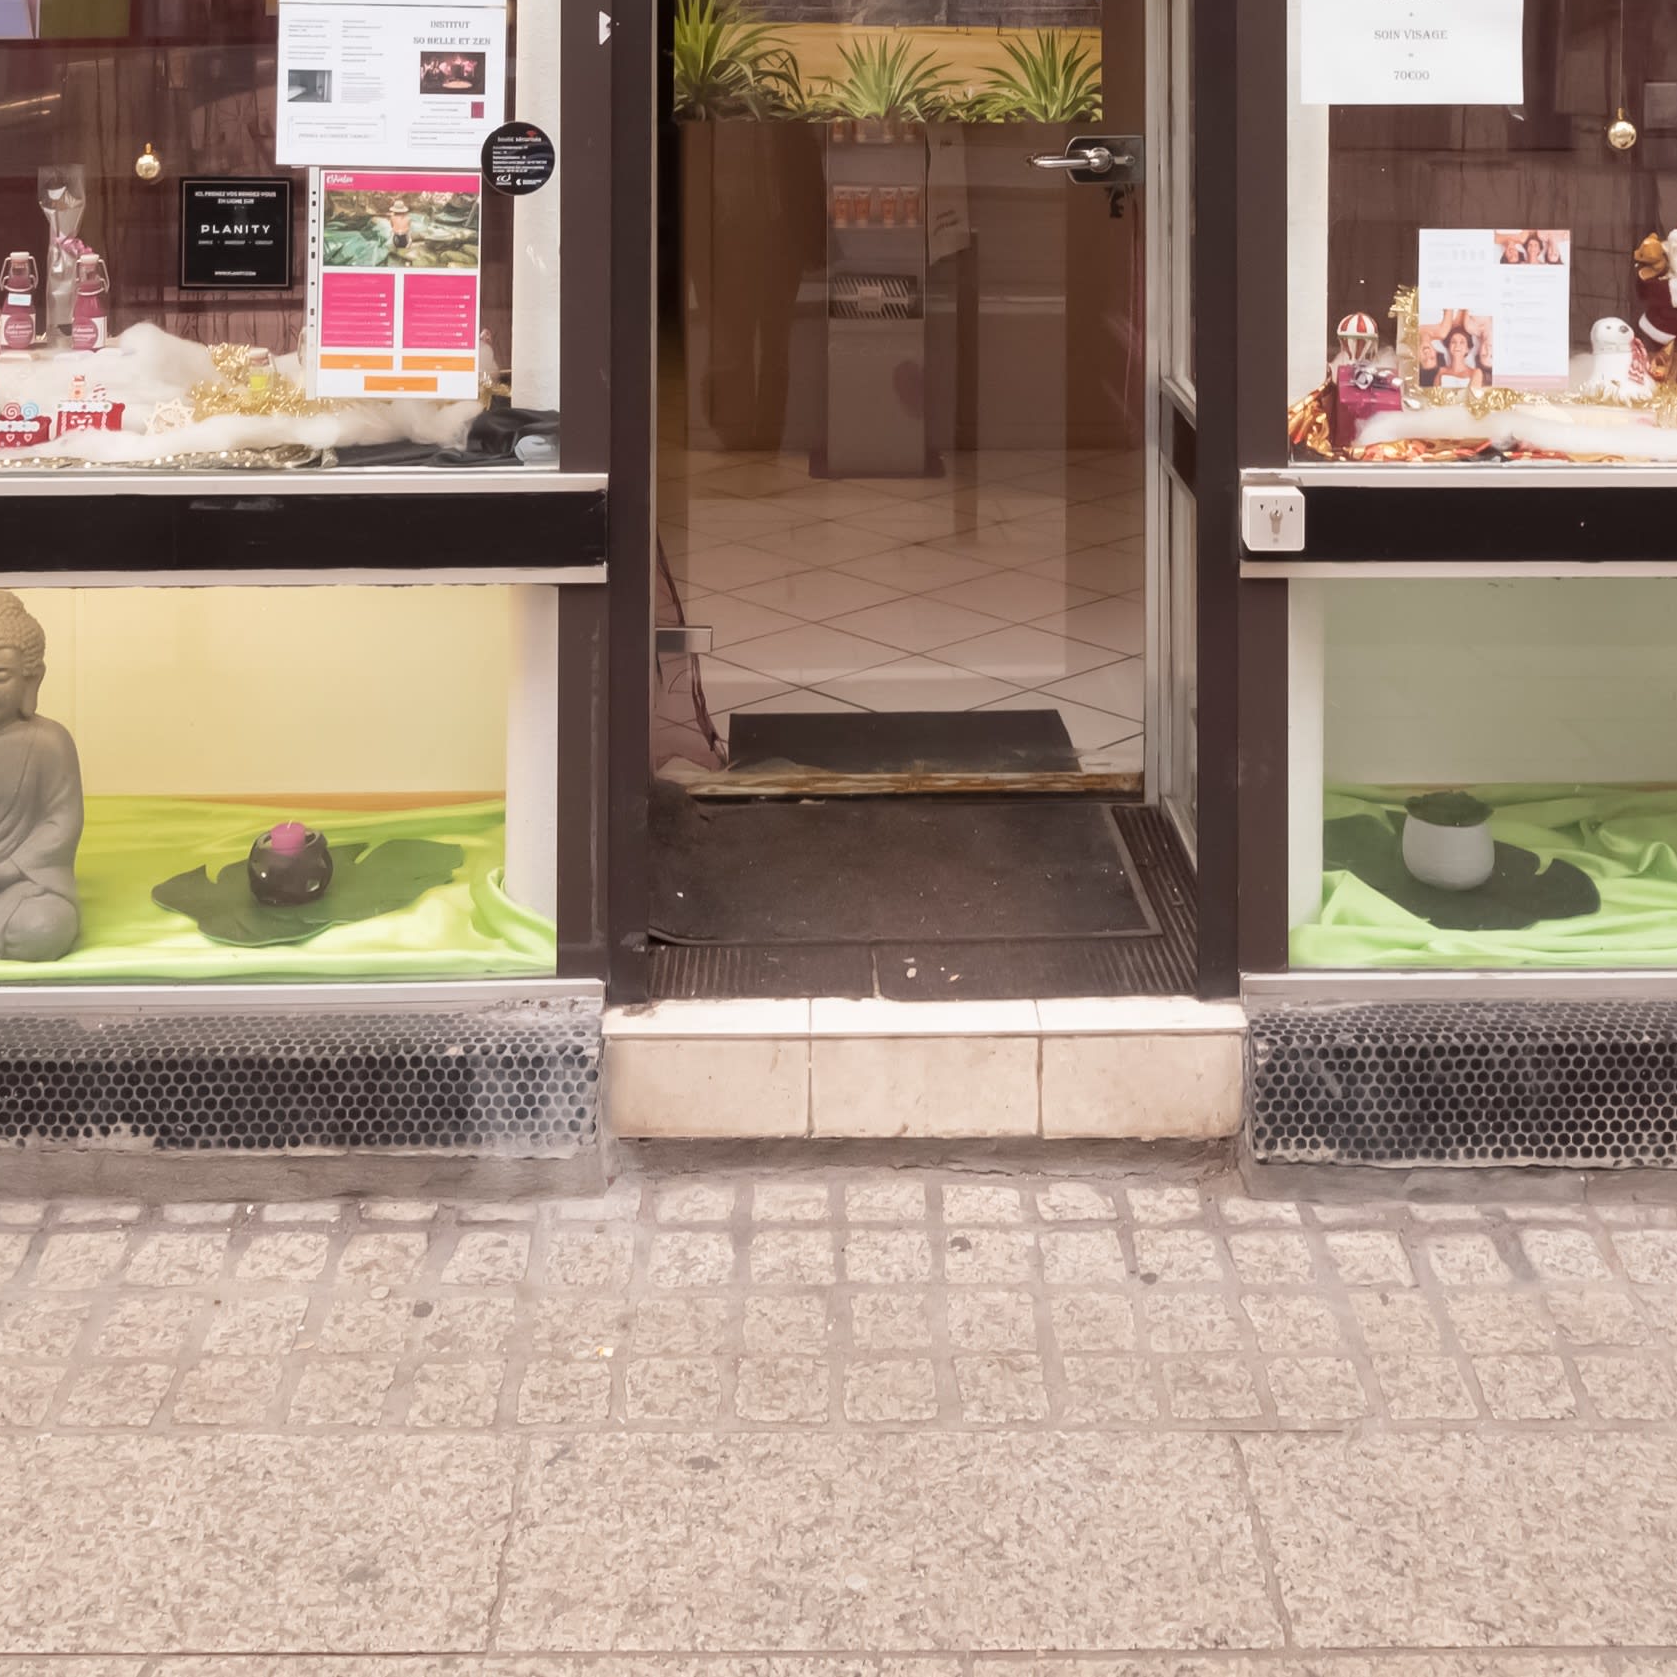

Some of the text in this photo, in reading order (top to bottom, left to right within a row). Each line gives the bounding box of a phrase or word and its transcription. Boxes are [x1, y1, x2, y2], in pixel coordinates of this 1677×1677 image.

[430, 20, 470, 29] INSTITUT
[1374, 30, 1448, 40] SOIN VISAGE
[200, 224, 270, 234] PLANITY
